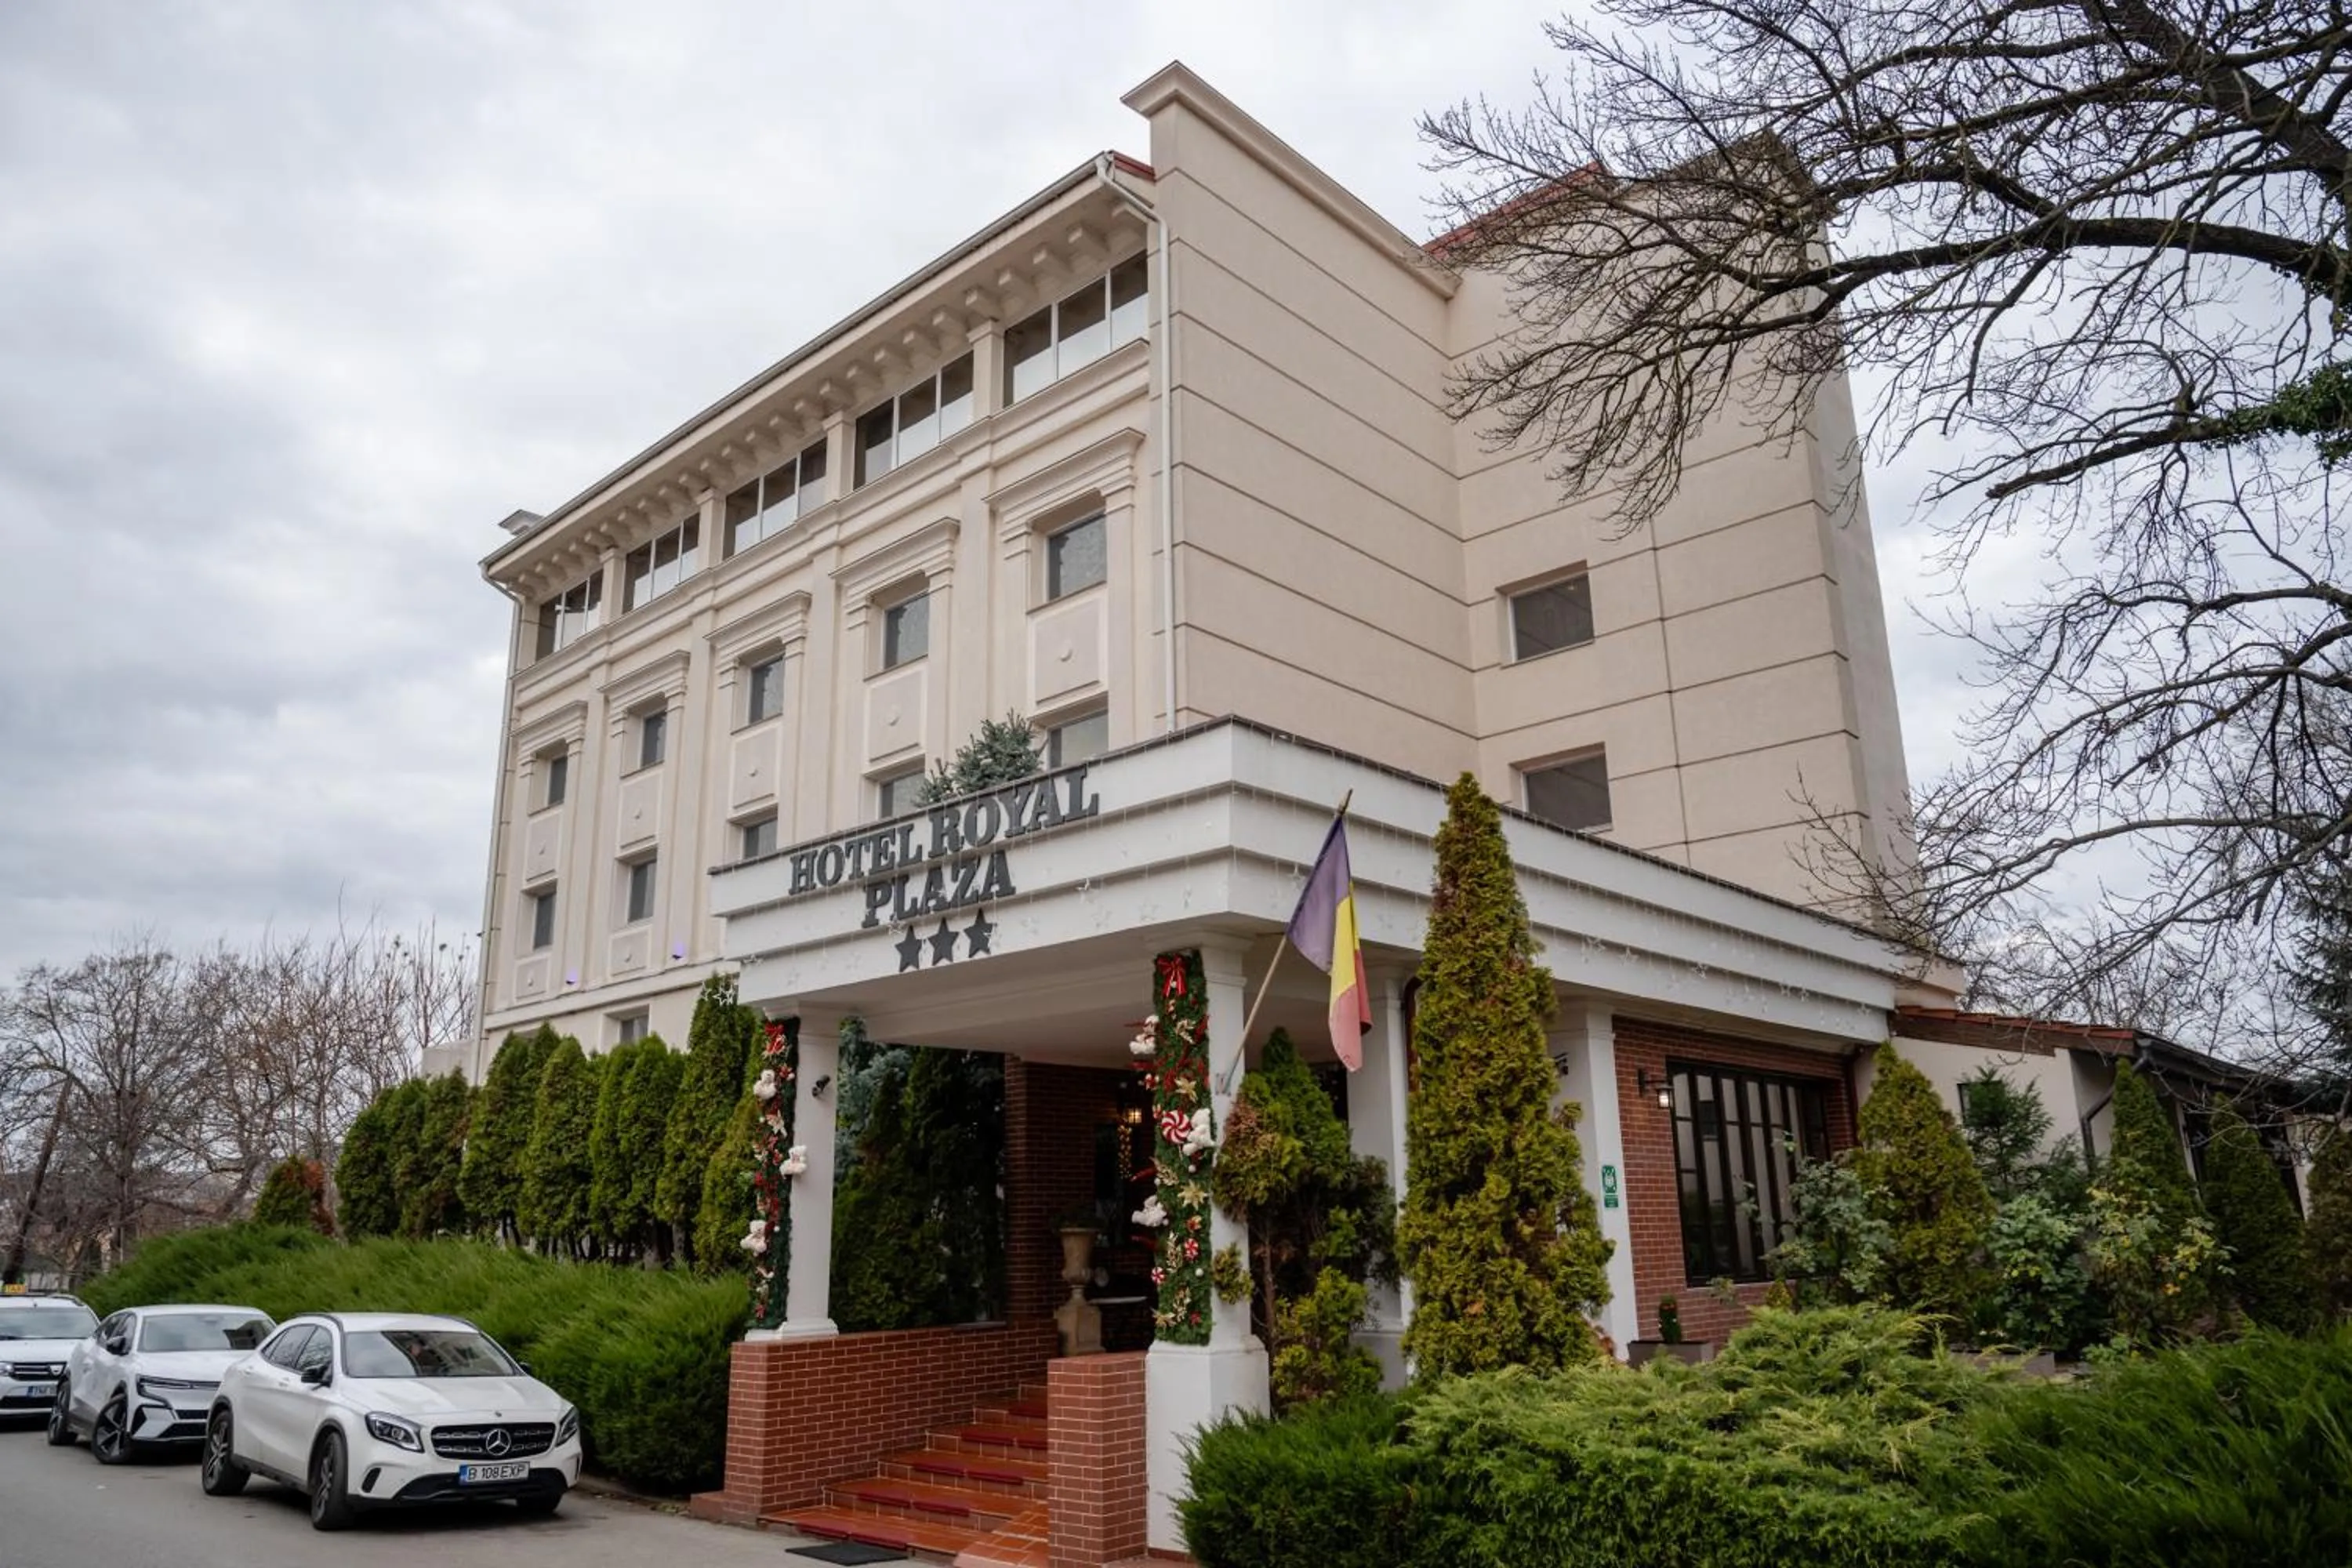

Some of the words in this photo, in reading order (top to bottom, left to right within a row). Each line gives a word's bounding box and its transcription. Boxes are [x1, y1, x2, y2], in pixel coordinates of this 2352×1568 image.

[789, 823, 922, 895] HOTEL
[928, 769, 1099, 858] ROYAL
[862, 849, 1016, 928] PLAZA
[468, 1467, 477, 1481] B
